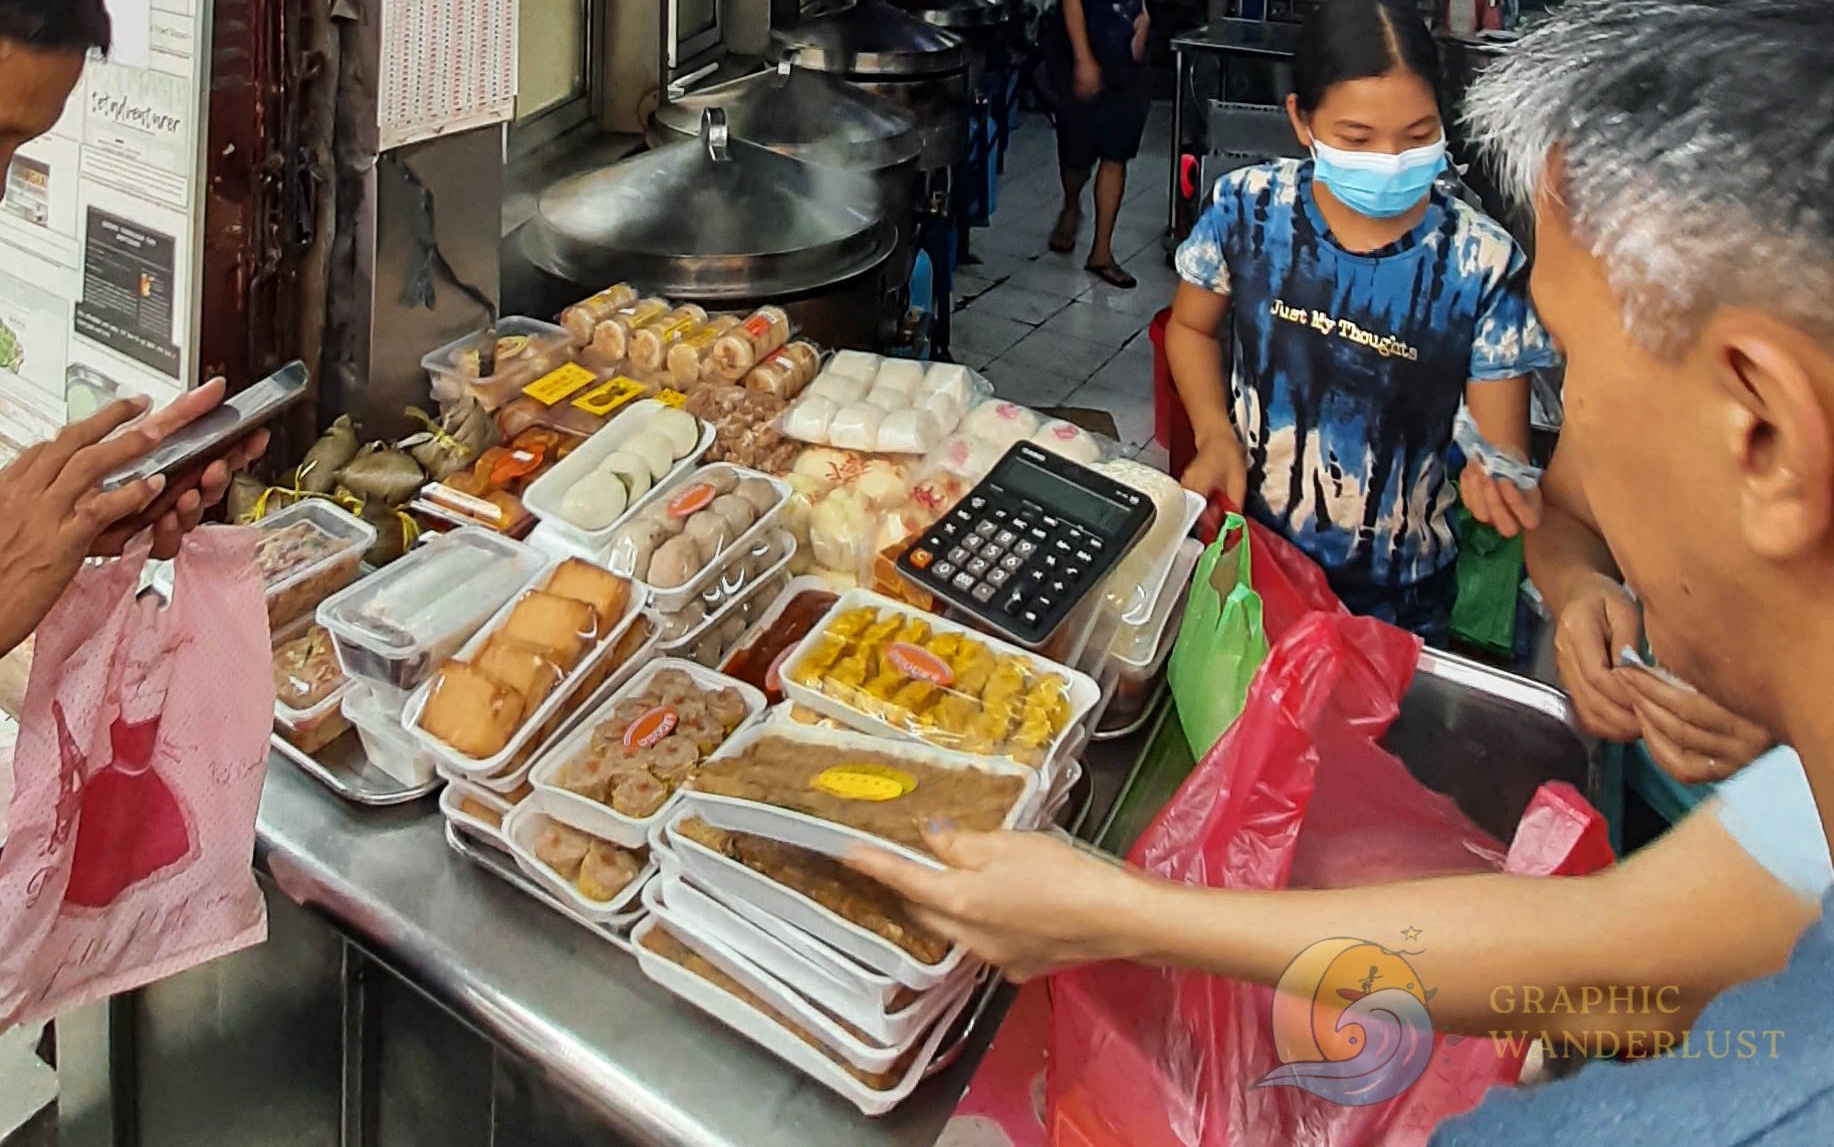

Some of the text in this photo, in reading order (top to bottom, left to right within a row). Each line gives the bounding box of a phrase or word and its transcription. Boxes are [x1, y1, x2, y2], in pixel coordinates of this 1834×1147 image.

[1270, 299, 1418, 361] Just My Thoughts
[969, 536, 1016, 566] 4 5 6
[983, 522, 1031, 551] 7 8 9
[917, 551, 927, 561] C
[939, 563, 950, 574] 0
[973, 558, 985, 569] 2
[994, 569, 1005, 581] 3
